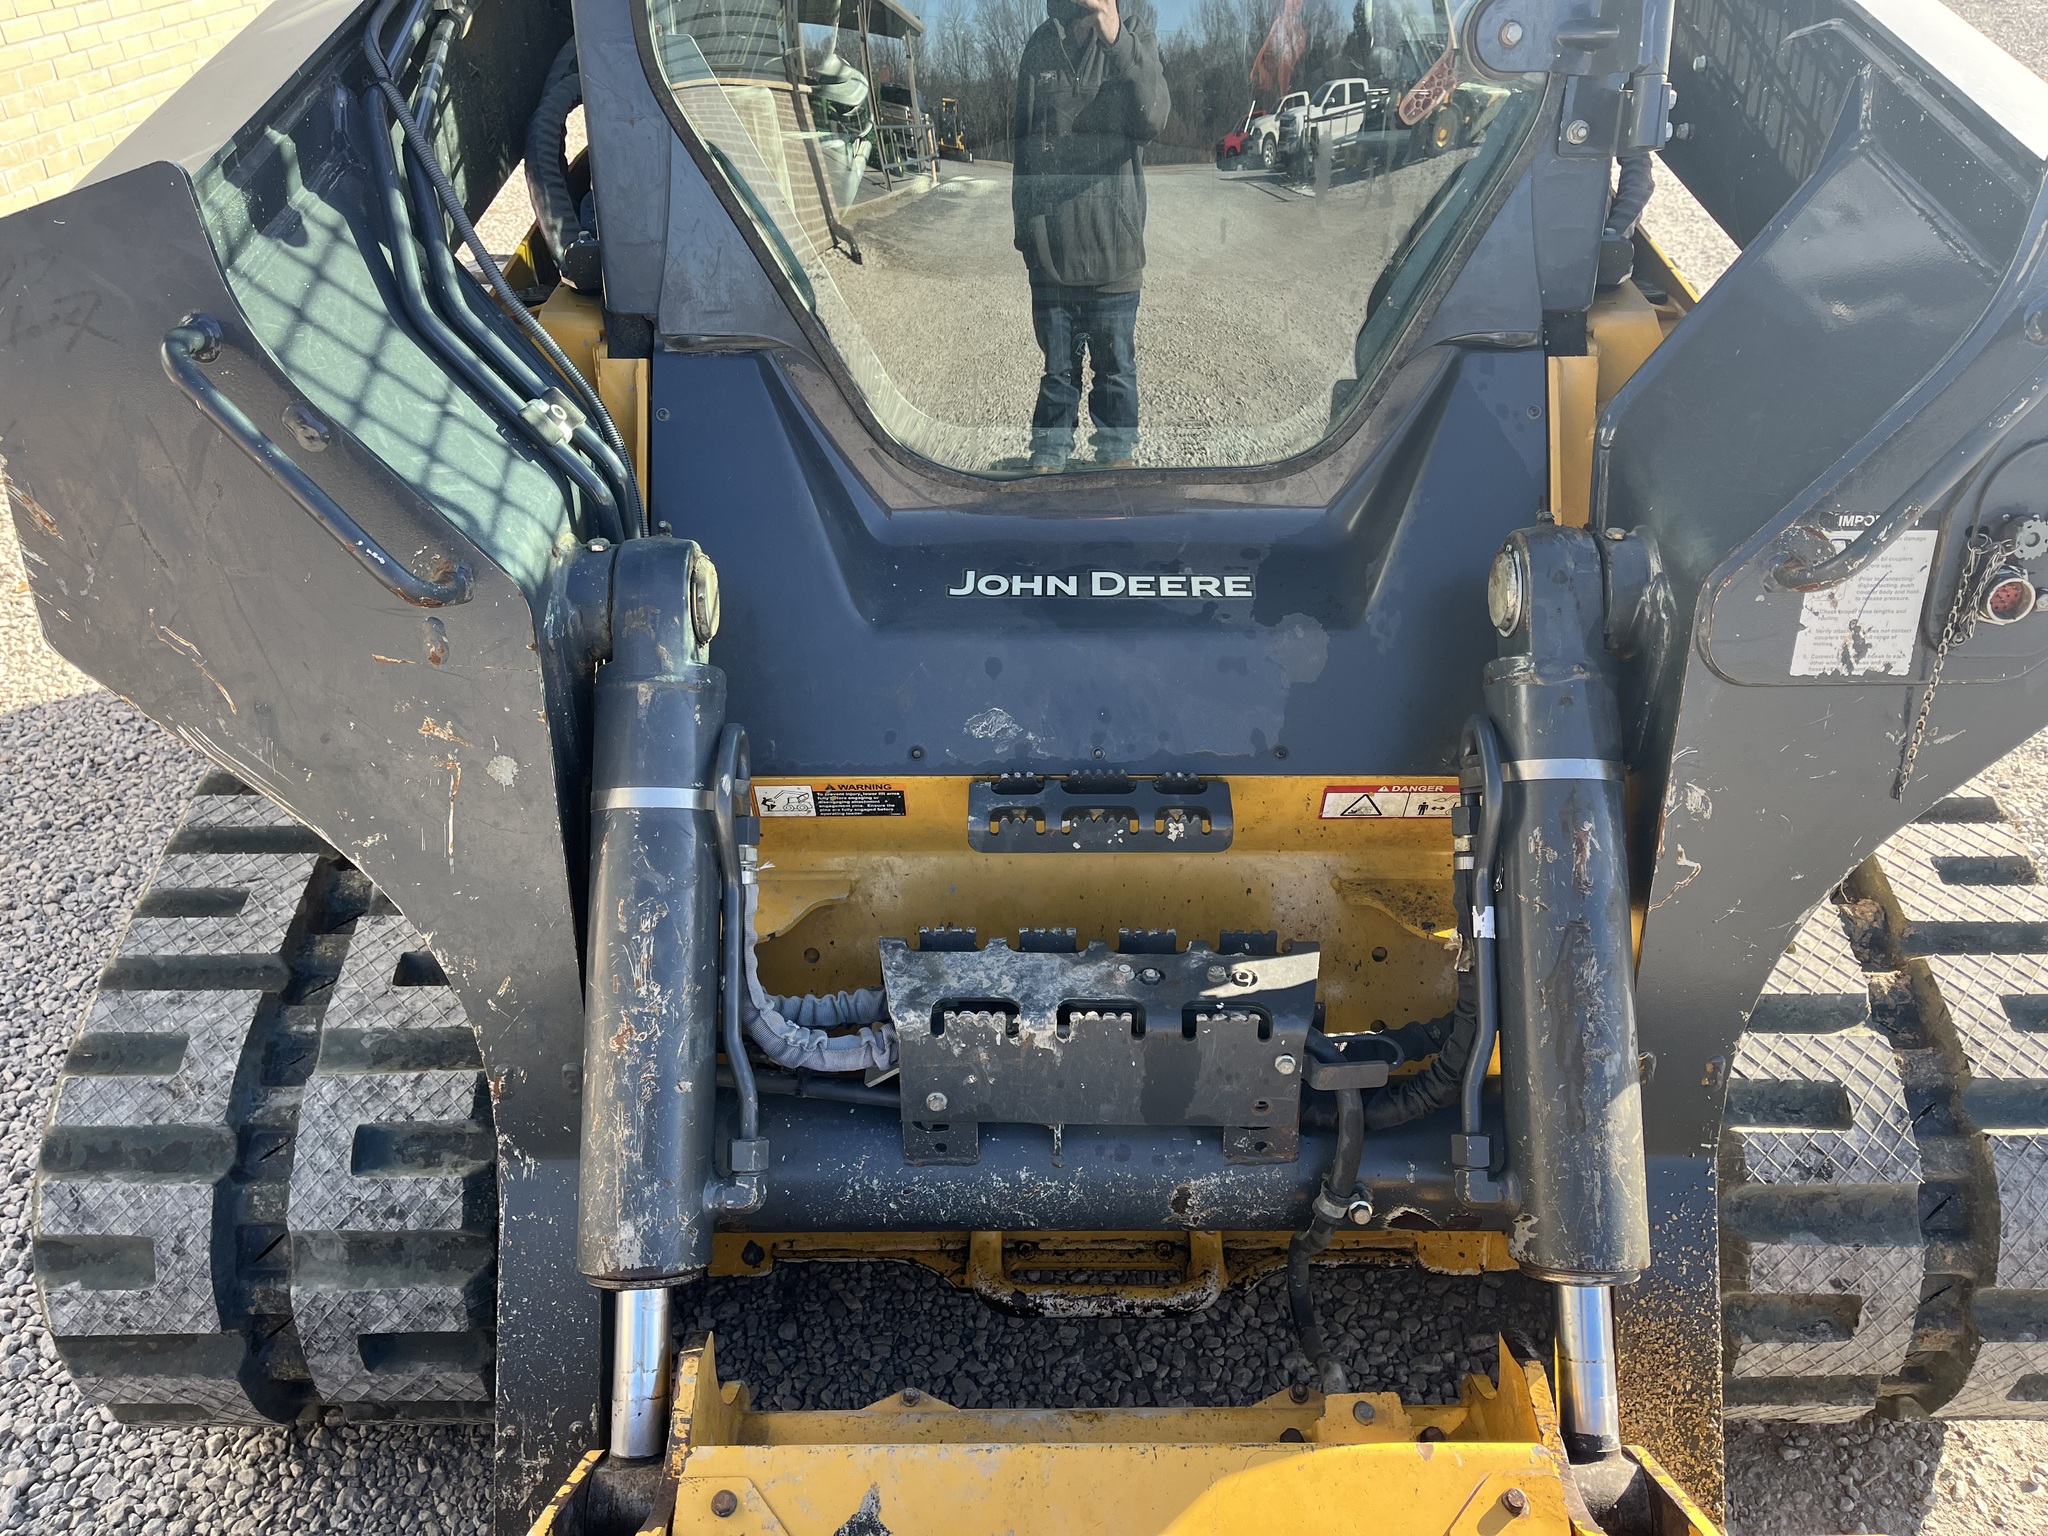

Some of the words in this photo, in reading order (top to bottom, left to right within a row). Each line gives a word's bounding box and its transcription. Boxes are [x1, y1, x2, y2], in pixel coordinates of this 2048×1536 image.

[949, 570, 1078, 597] JOHN
[1091, 571, 1253, 597] DEERE
[837, 783, 892, 791] WARNING
